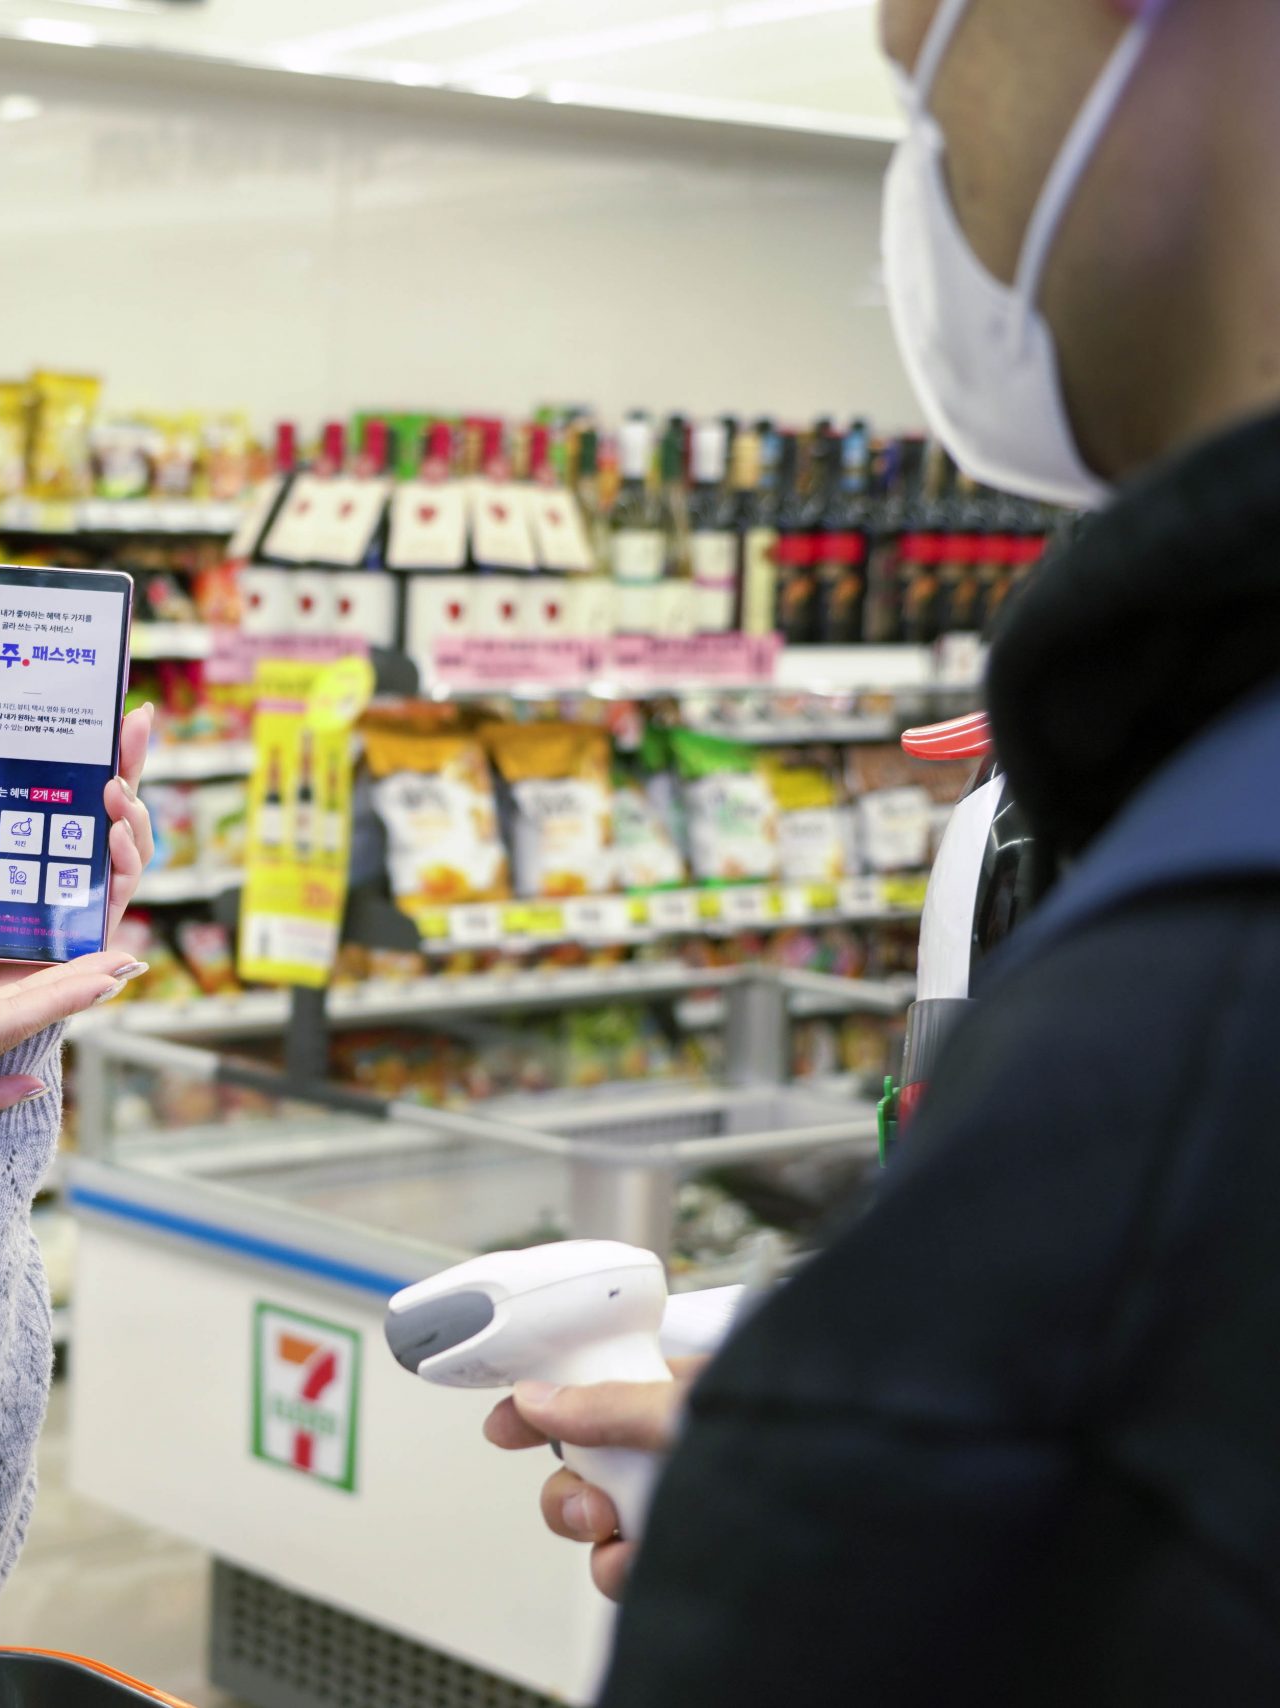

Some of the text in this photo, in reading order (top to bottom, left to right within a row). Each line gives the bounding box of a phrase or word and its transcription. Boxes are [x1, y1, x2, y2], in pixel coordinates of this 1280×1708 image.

[1, 609, 15, 618] 내가
[16, 609, 45, 620] 좋아하는
[46, 611, 61, 621] 혜택
[62, 613, 70, 622] 두
[71, 613, 92, 623] 가지를
[2, 621, 16, 630] 골라
[17, 622, 32, 632] 쓰는
[33, 623, 48, 632] 구독
[81, 708, 94, 716] 가지
[4, 713, 17, 721] 내가
[17, 714, 37, 722] 원하는
[37, 715, 50, 723] 혜택
[58, 717, 77, 725] 가지를
[43, 726, 55, 734] 구독
[56, 727, 75, 735] 서비스
[9, 787, 29, 800] 혜택
[32, 789, 49, 801] 2개
[50, 790, 70, 802] 선택
[14, 840, 27, 848] 치킨
[64, 843, 77, 851] 택시
[10, 888, 23, 896] 뷰티
